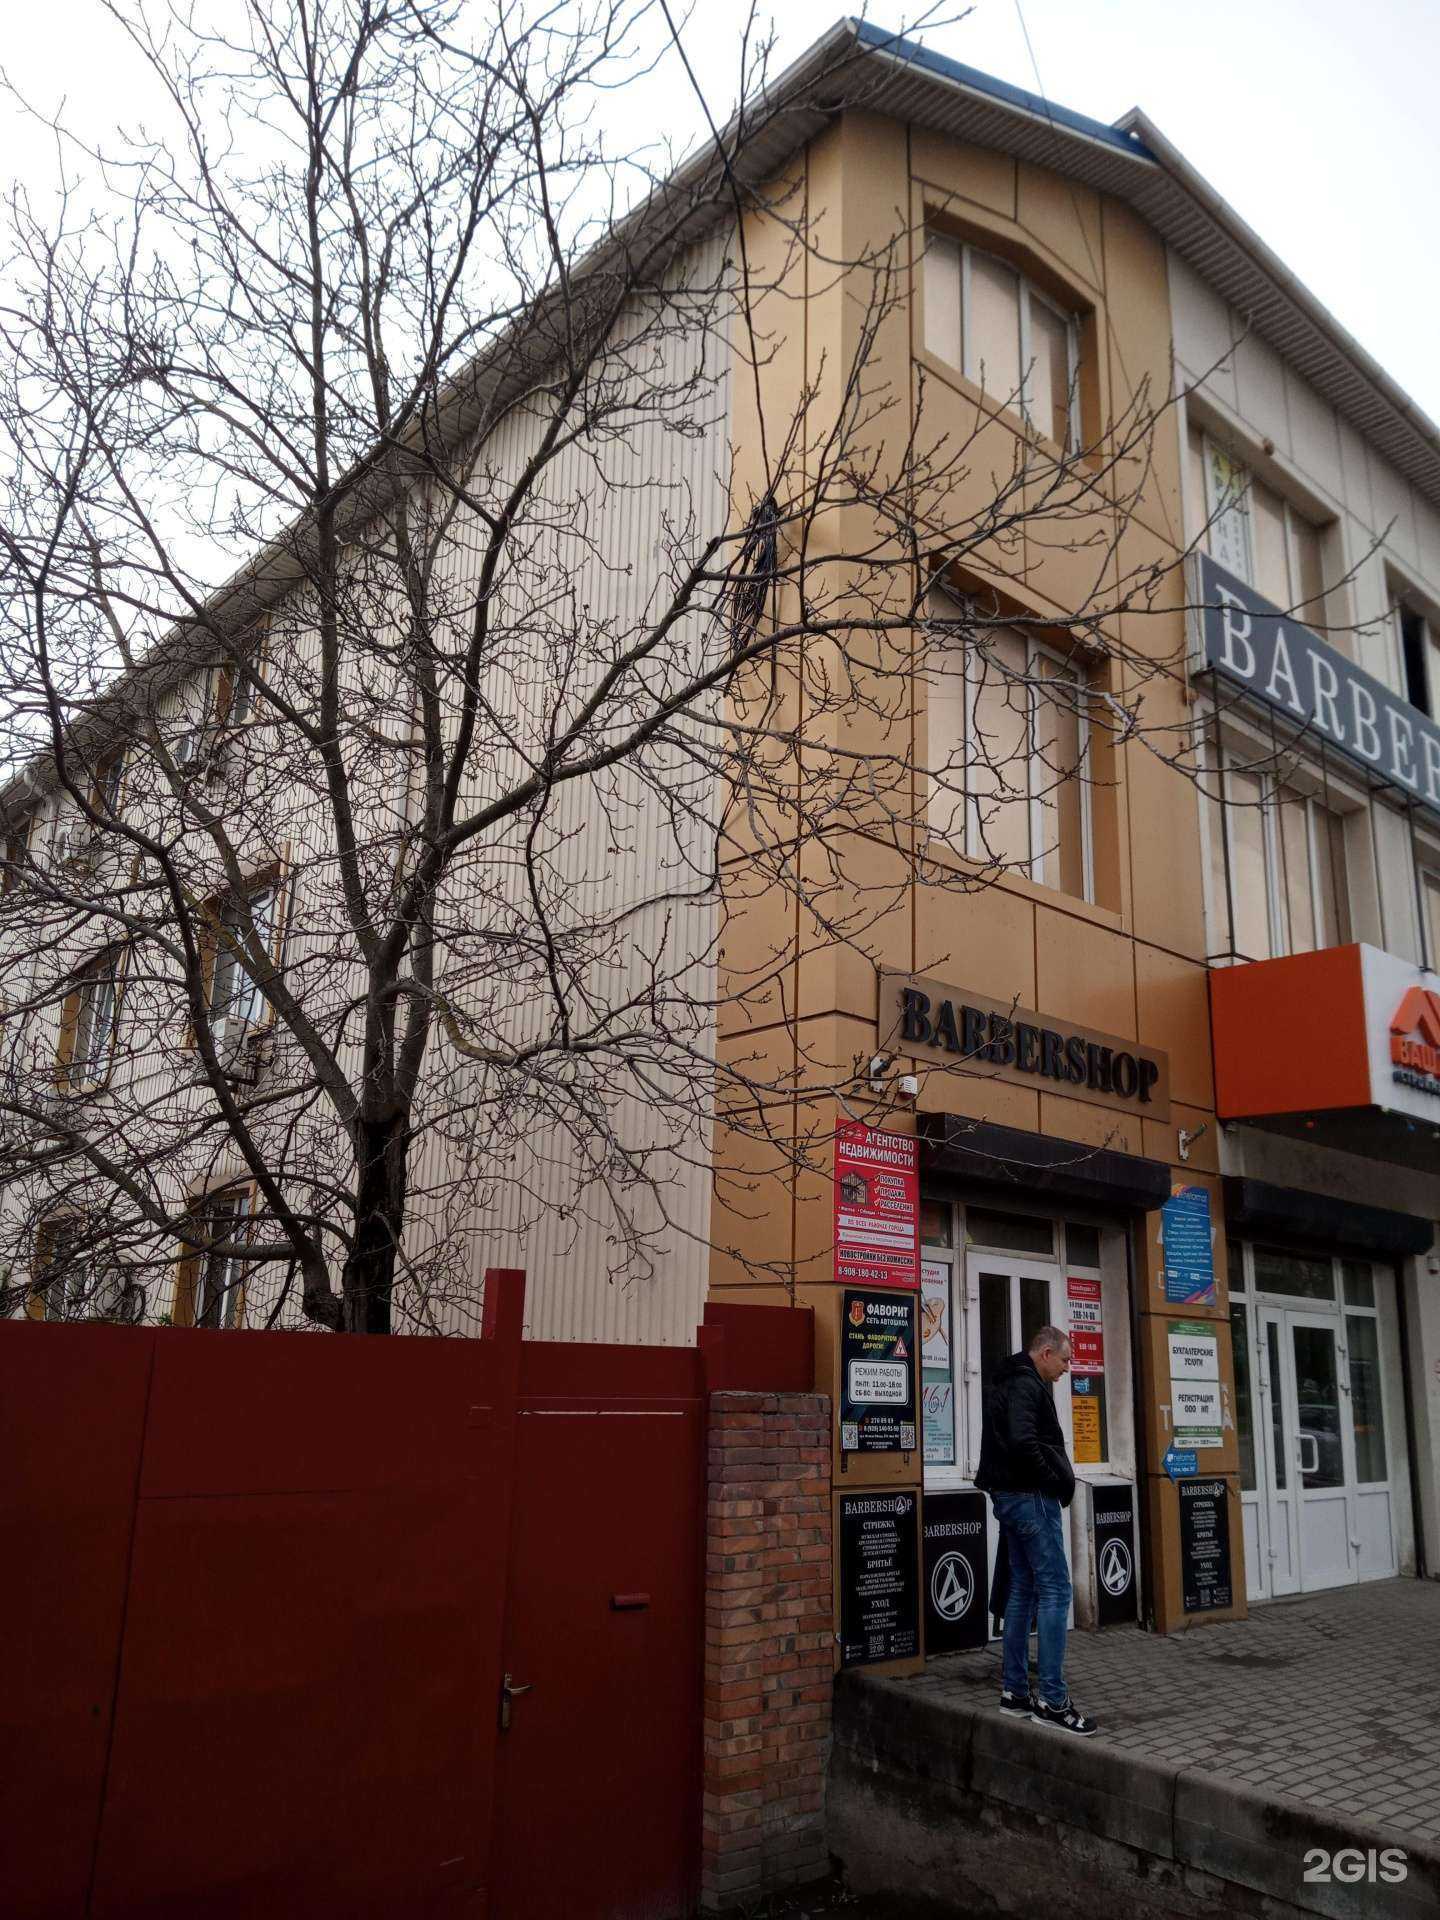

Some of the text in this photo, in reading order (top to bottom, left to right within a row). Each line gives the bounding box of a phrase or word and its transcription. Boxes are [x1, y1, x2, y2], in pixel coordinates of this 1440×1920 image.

[899, 987, 1160, 1104] BARBERSHOP
[865, 1132, 914, 1152] АГЕНТСТВО
[839, 1141, 914, 1168] НЕДВИЖИМОСТИ
[880, 1174, 905, 1187] ПОКУПКА
[880, 1187, 906, 1199] ПРОДАЖА
[880, 1199, 914, 1213] РАССЕЛЕНИЕ
[839, 1249, 914, 1265] НОВОСТРОЙКИ БЕЗ КОМИССИИ
[866, 1303, 909, 1318] ФАВОРИТ
[866, 1317, 909, 1327] СЕТЬ АВТОШКОЛ
[848, 1332, 898, 1342] СТАНЬ ФАВОРИТОМ
[1172, 1346, 1214, 1357] БУХГАЛТЕРСКИЕ
[1184, 1358, 1203, 1367] УСЛУГИ
[855, 1367, 903, 1378] РЕЖИМ РАБОТЫ
[874, 1390, 903, 1398] ВЫХОДНОЙ
[1178, 1394, 1214, 1404] РЕГИСТРАЦИЯ
[1184, 1404, 1196, 1414] ООО
[1096, 1511, 1131, 1524] BARBERSHOP
[863, 1520, 895, 1530] СТРИЖКА
[871, 1599, 890, 1609] УХОД
